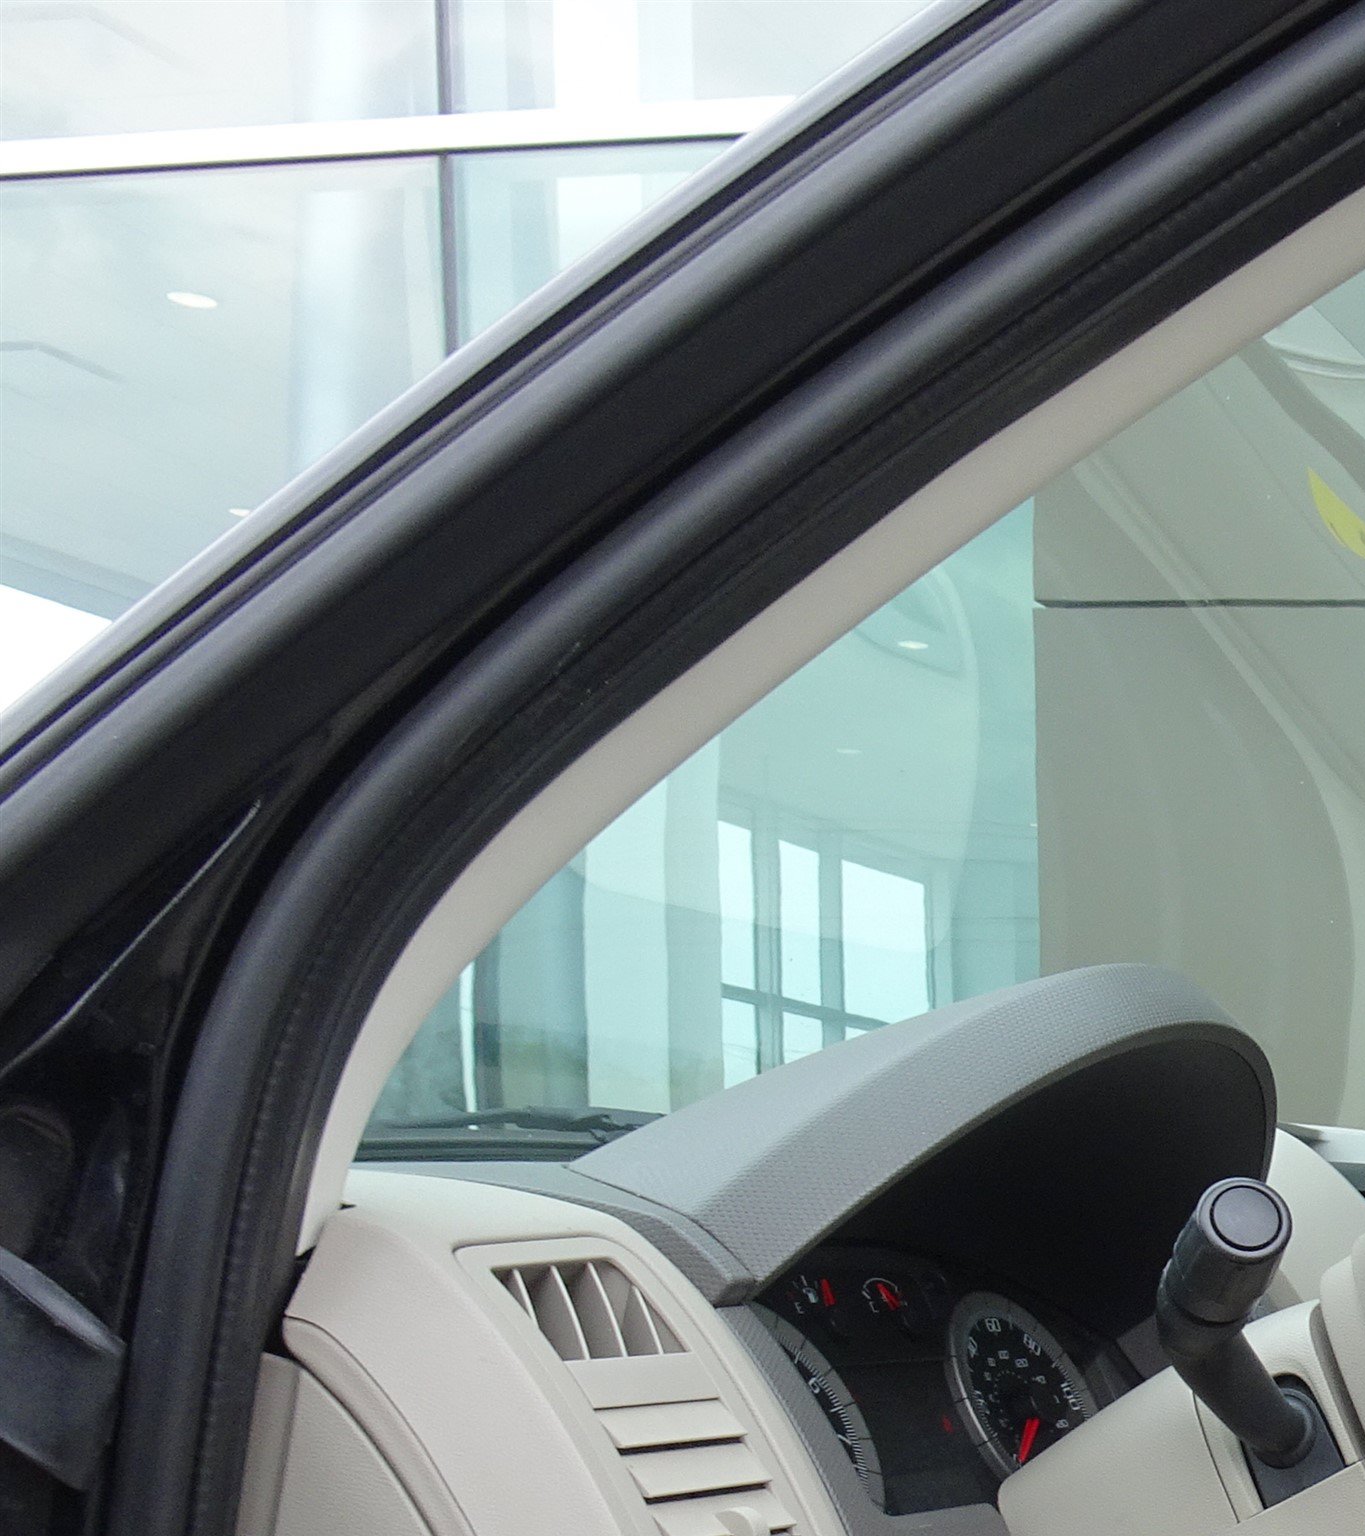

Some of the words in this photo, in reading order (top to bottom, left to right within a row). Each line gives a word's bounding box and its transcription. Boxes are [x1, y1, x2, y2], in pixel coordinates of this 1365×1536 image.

[985, 1318, 1001, 1332] 60
[1023, 1333, 1041, 1356] 80
[1060, 1382, 1080, 1411] 100
